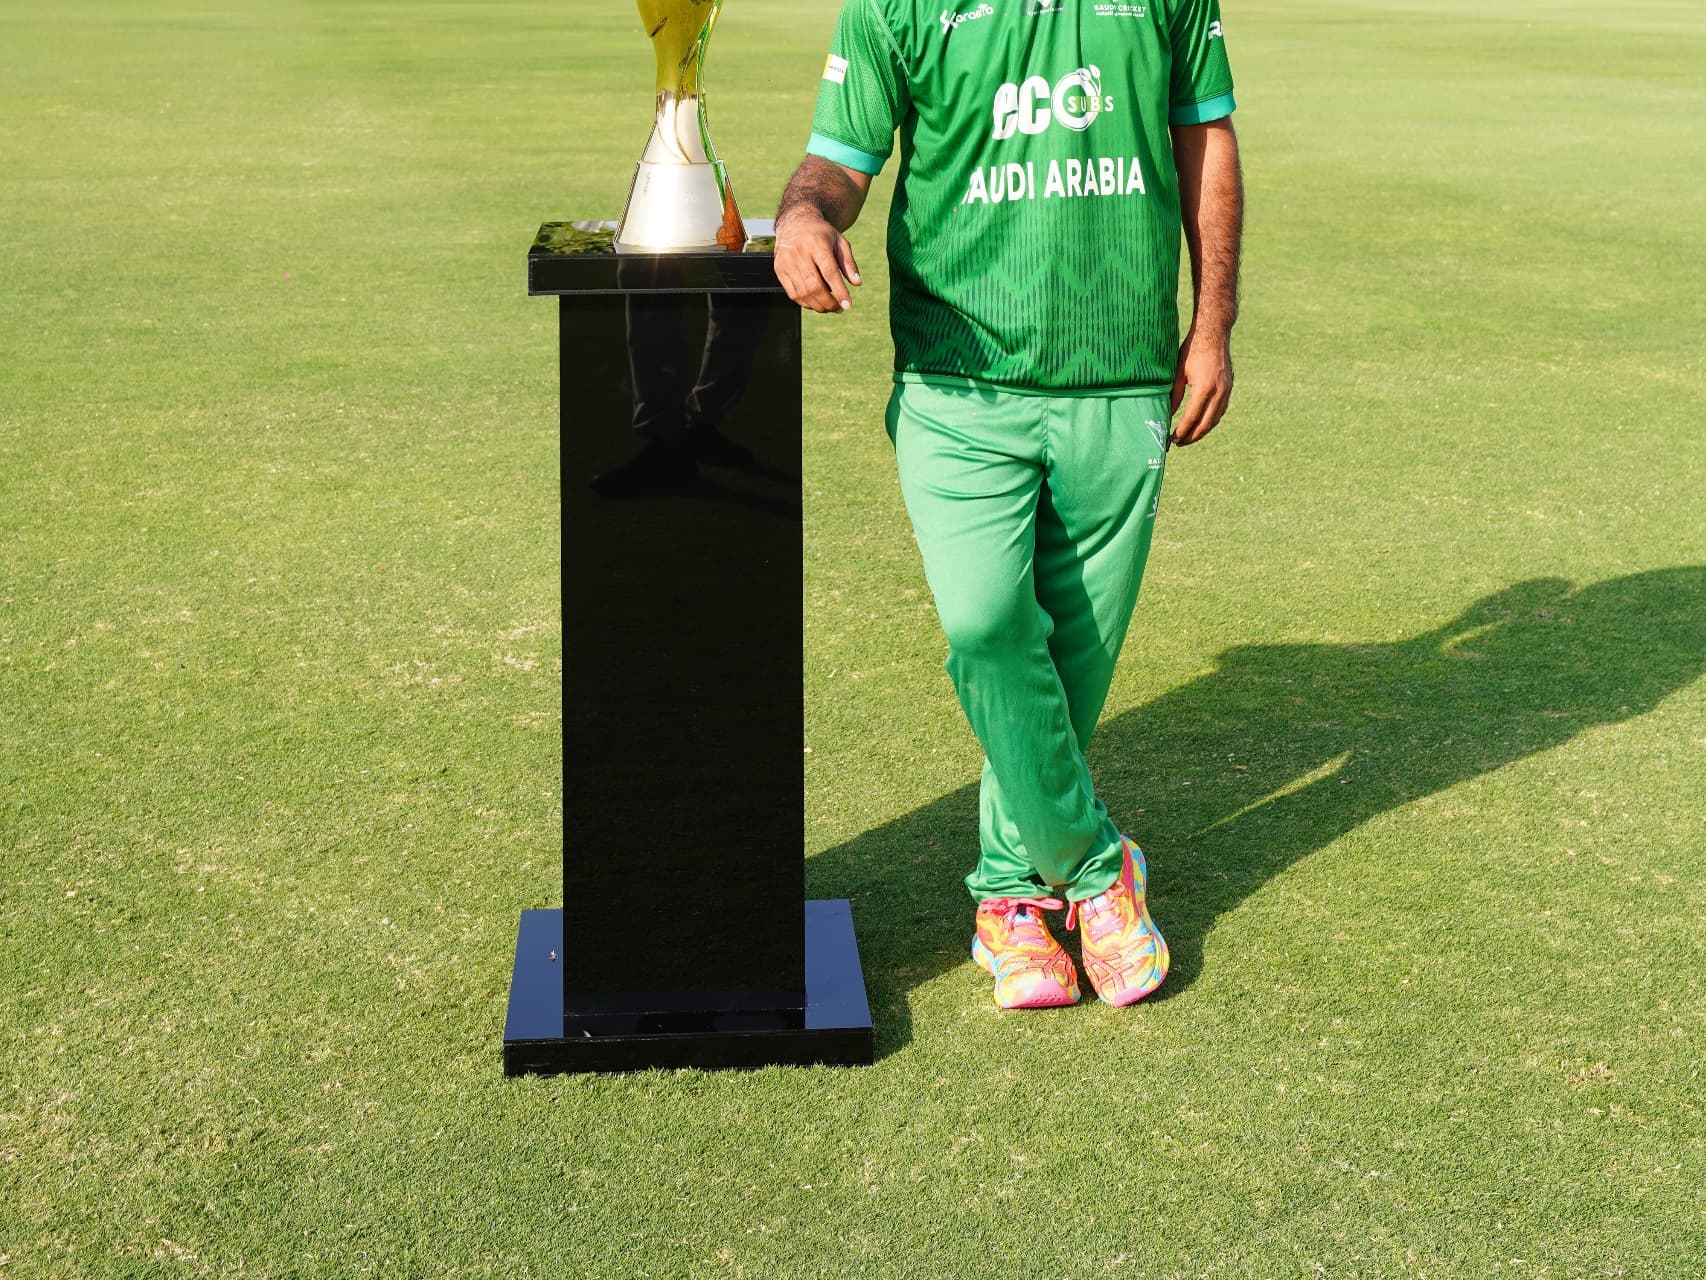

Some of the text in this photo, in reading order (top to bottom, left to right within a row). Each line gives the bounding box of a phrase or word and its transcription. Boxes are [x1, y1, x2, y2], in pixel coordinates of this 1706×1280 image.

[1117, 4, 1147, 12] CRICKET
[1067, 95, 1114, 112] SUBS
[1043, 156, 1146, 198] ARABIA
